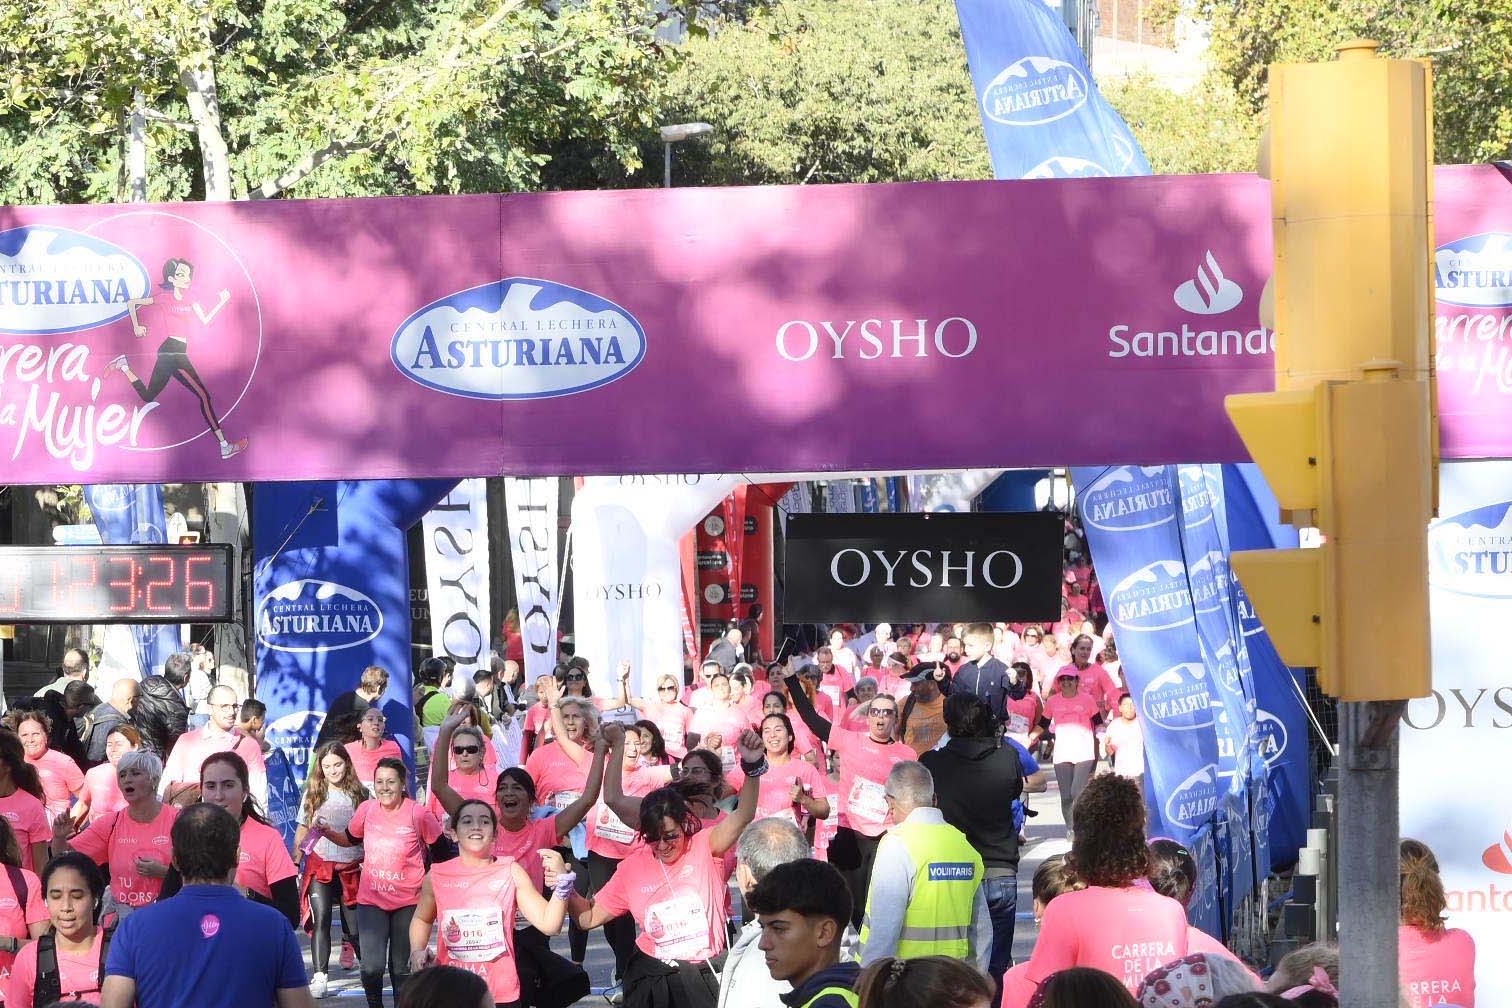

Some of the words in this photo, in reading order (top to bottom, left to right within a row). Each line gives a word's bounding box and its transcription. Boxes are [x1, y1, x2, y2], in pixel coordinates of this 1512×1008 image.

[450, 320, 528, 332] CENTRAL
[536, 318, 618, 330] LECHERA
[411, 324, 627, 371] ASTURIANA
[775, 316, 978, 361] OYSHO
[11, 376, 160, 472] Mujer
[830, 547, 1024, 589] OYSHO
[273, 605, 315, 613] CENTRAL
[262, 609, 374, 635] ASTURIANA
[119, 892, 152, 903] DORS
[1111, 943, 1176, 958] CARRERA
[1125, 959, 1141, 972] DE
